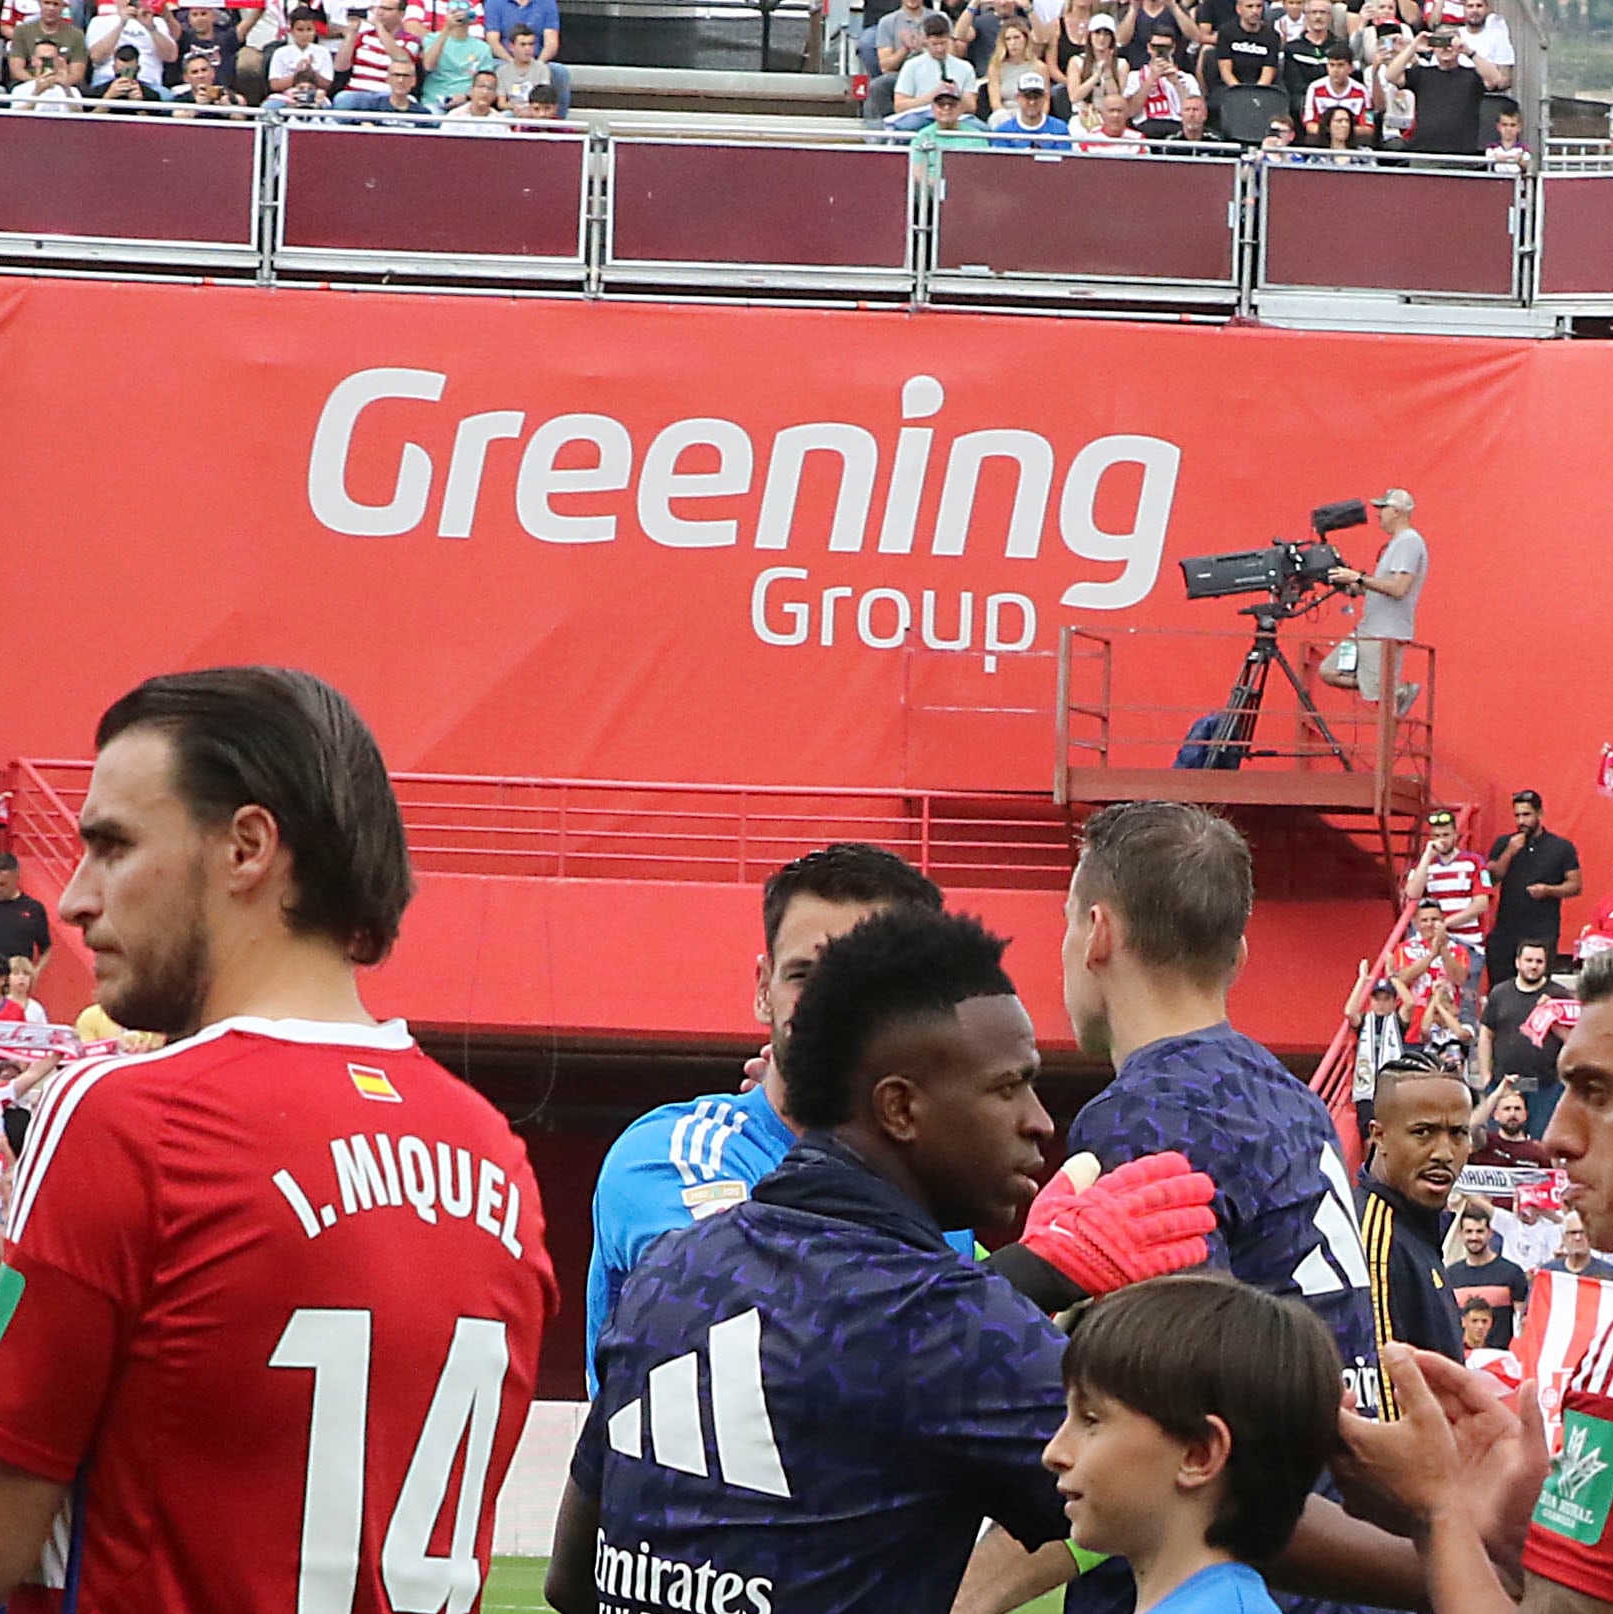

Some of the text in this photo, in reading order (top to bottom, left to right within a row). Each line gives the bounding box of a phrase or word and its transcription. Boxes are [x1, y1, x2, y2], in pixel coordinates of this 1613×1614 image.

[307, 368, 1181, 609] Greening
[751, 564, 1036, 672] Group
[272, 1133, 524, 1260] I.MIQUEL
